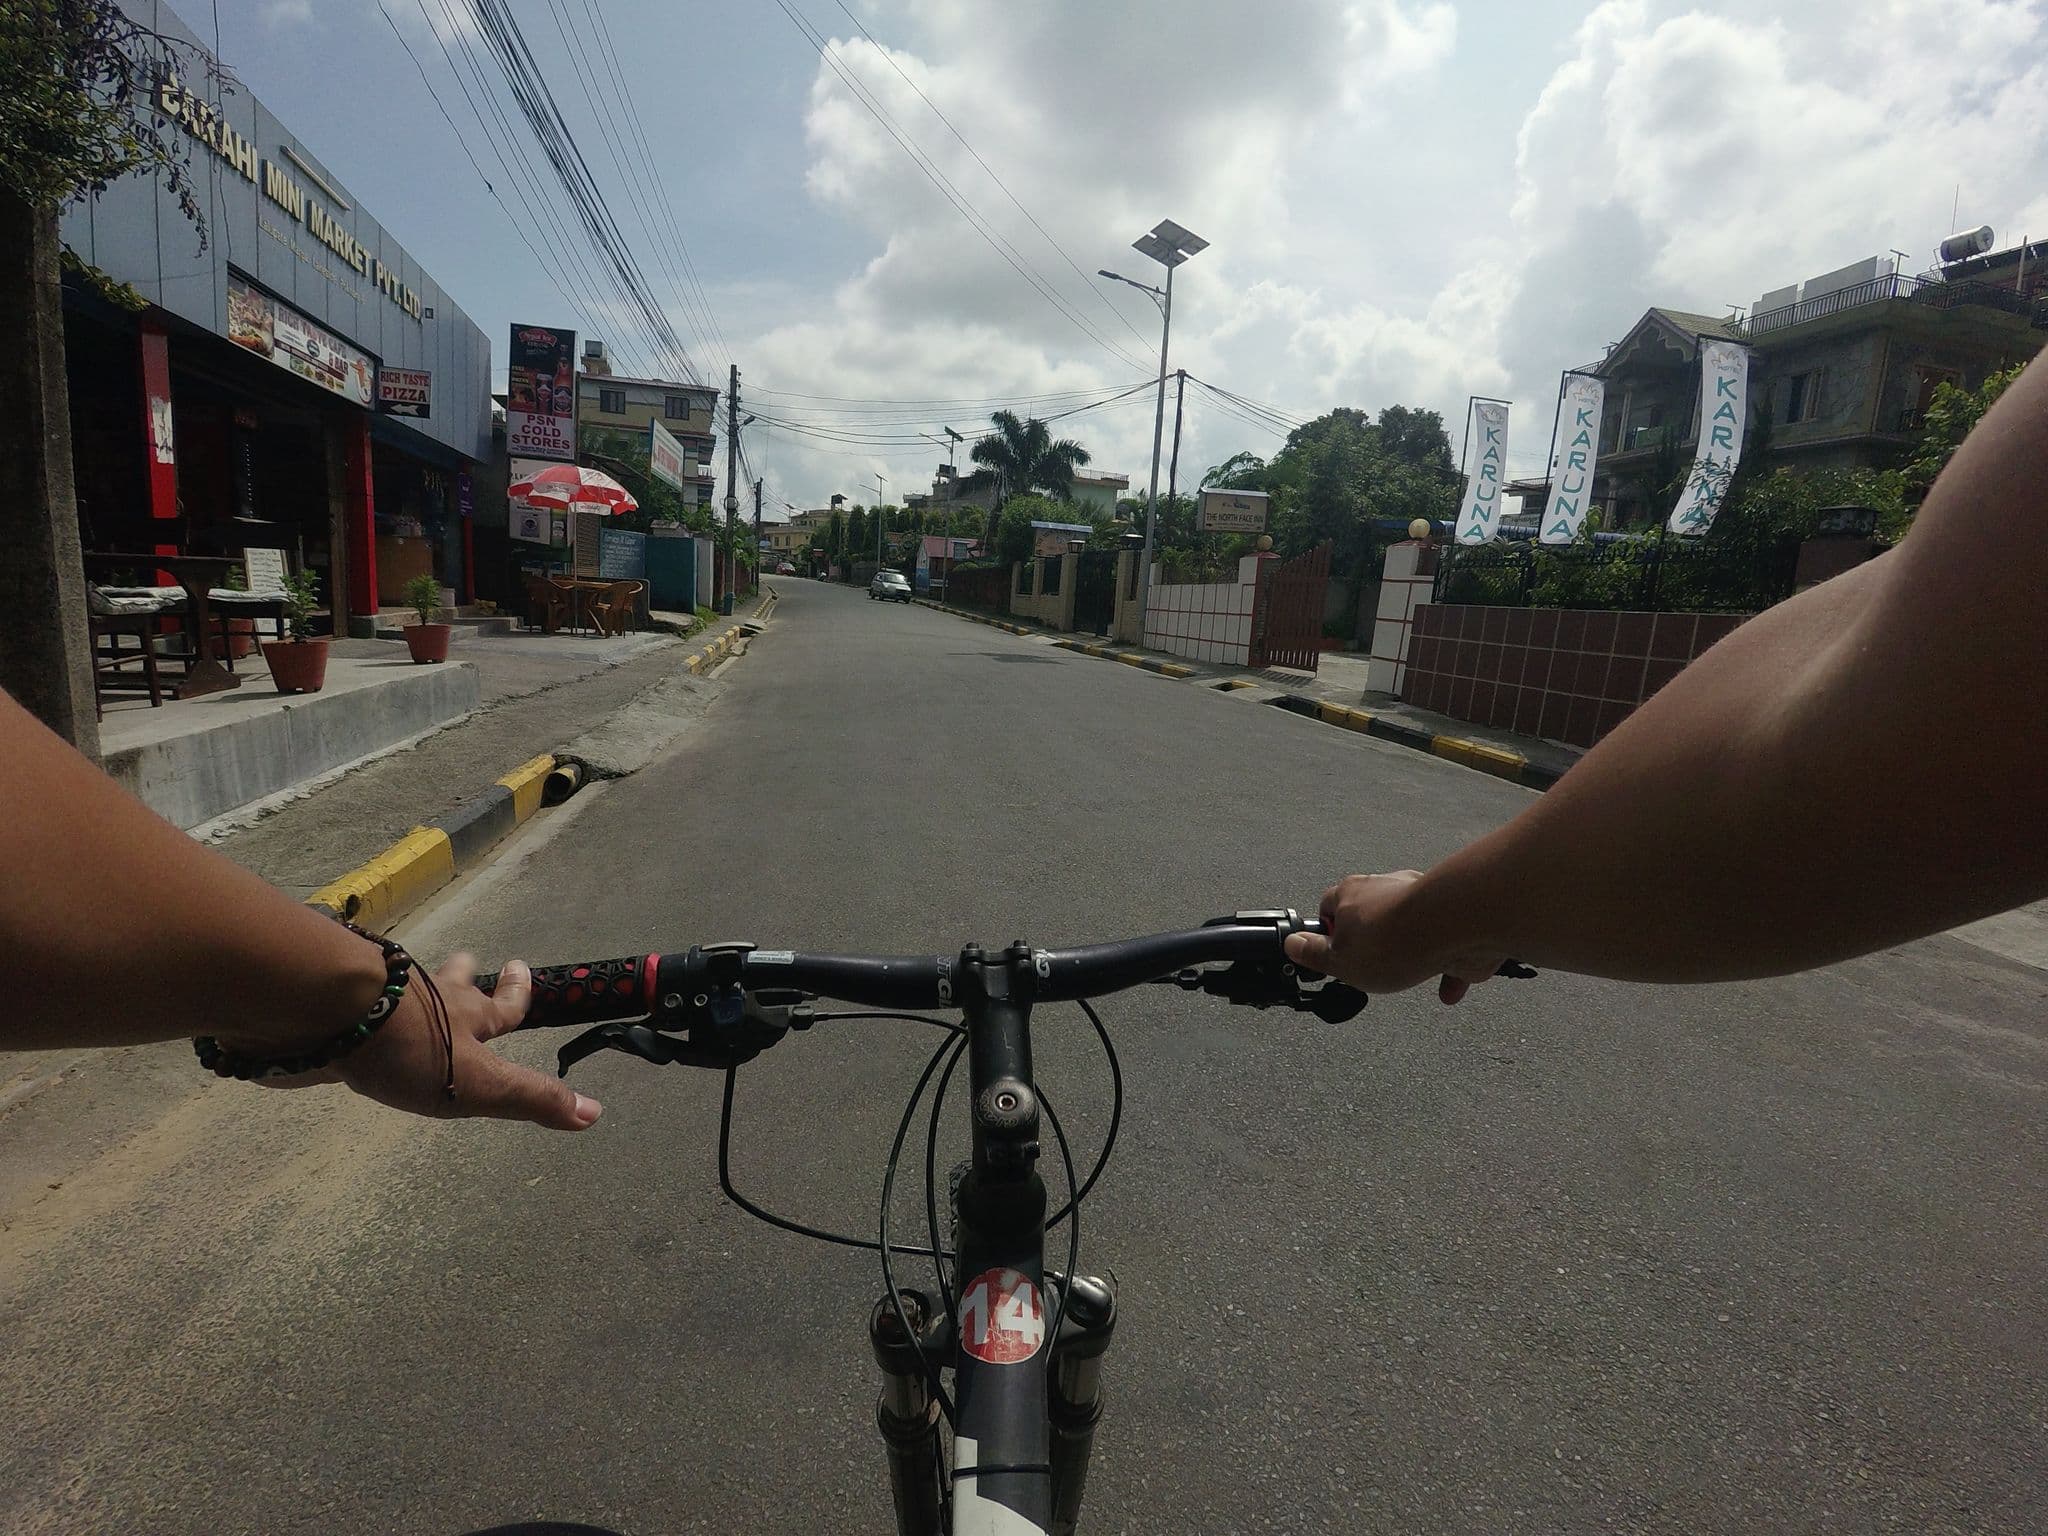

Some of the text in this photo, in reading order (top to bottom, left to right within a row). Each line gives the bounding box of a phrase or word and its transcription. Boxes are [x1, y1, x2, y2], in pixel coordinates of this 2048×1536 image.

[265, 159, 304, 224] MINI
[311, 199, 372, 277] MARKET
[278, 305, 299, 331] RICH
[334, 355, 348, 376] BAR
[380, 371, 430, 386] RICH TASTE
[382, 386, 427, 402] PIZZA
[527, 414, 556, 427] PSN
[521, 424, 561, 437] COLD
[511, 433, 570, 449] STORES
[1546, 407, 1593, 538] KARUNA
[1463, 427, 1500, 540] KARUNA
[1206, 512, 1218, 521] THE
[1219, 513, 1238, 521] NORTH
[1238, 514, 1254, 523] FACE
[958, 1282, 1044, 1346] 14
